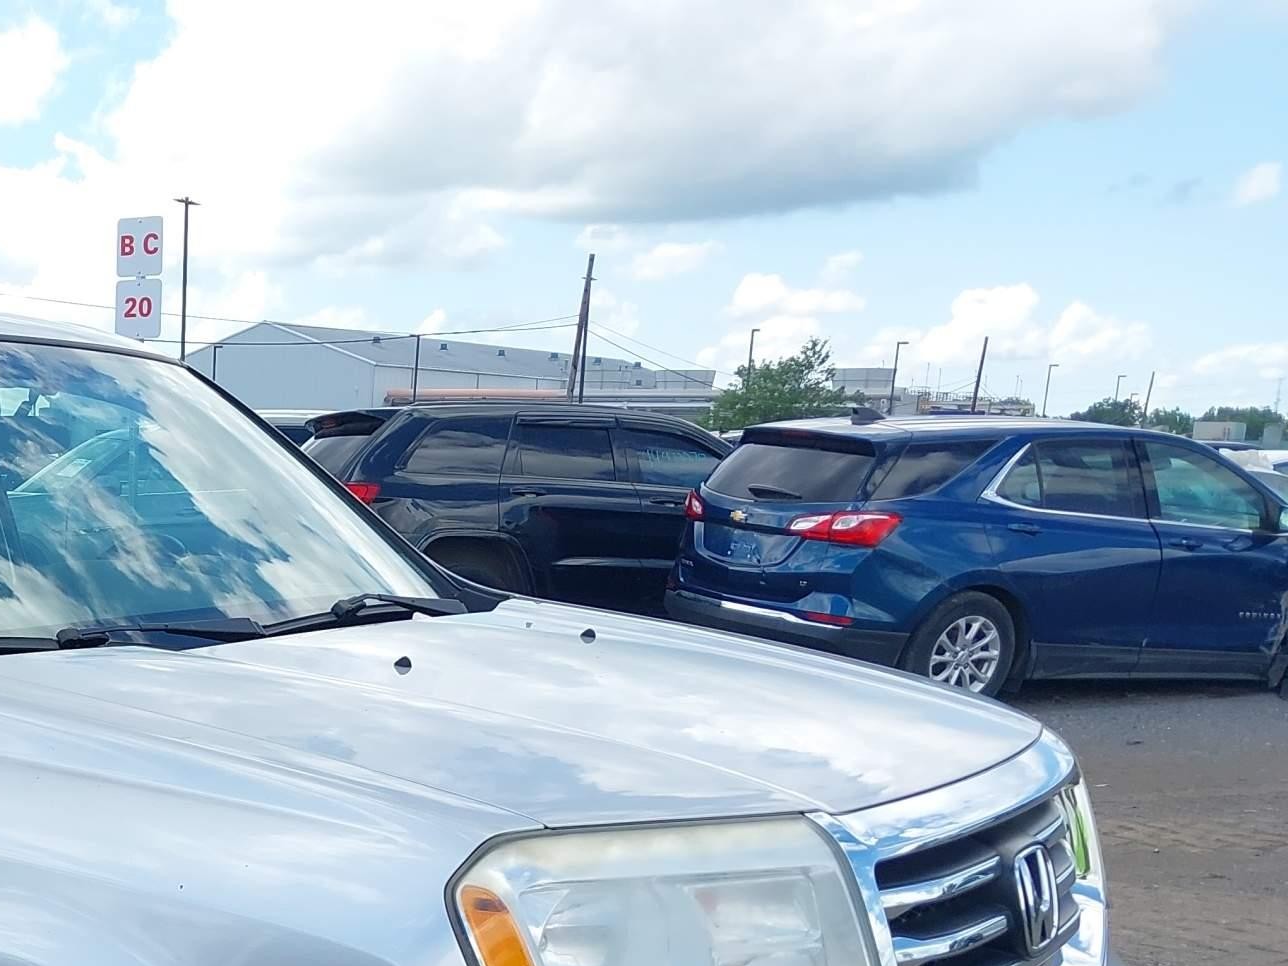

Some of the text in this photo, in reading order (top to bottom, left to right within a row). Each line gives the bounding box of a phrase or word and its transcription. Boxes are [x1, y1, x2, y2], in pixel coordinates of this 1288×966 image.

[120, 232, 159, 257] B C
[123, 296, 153, 318] 20
